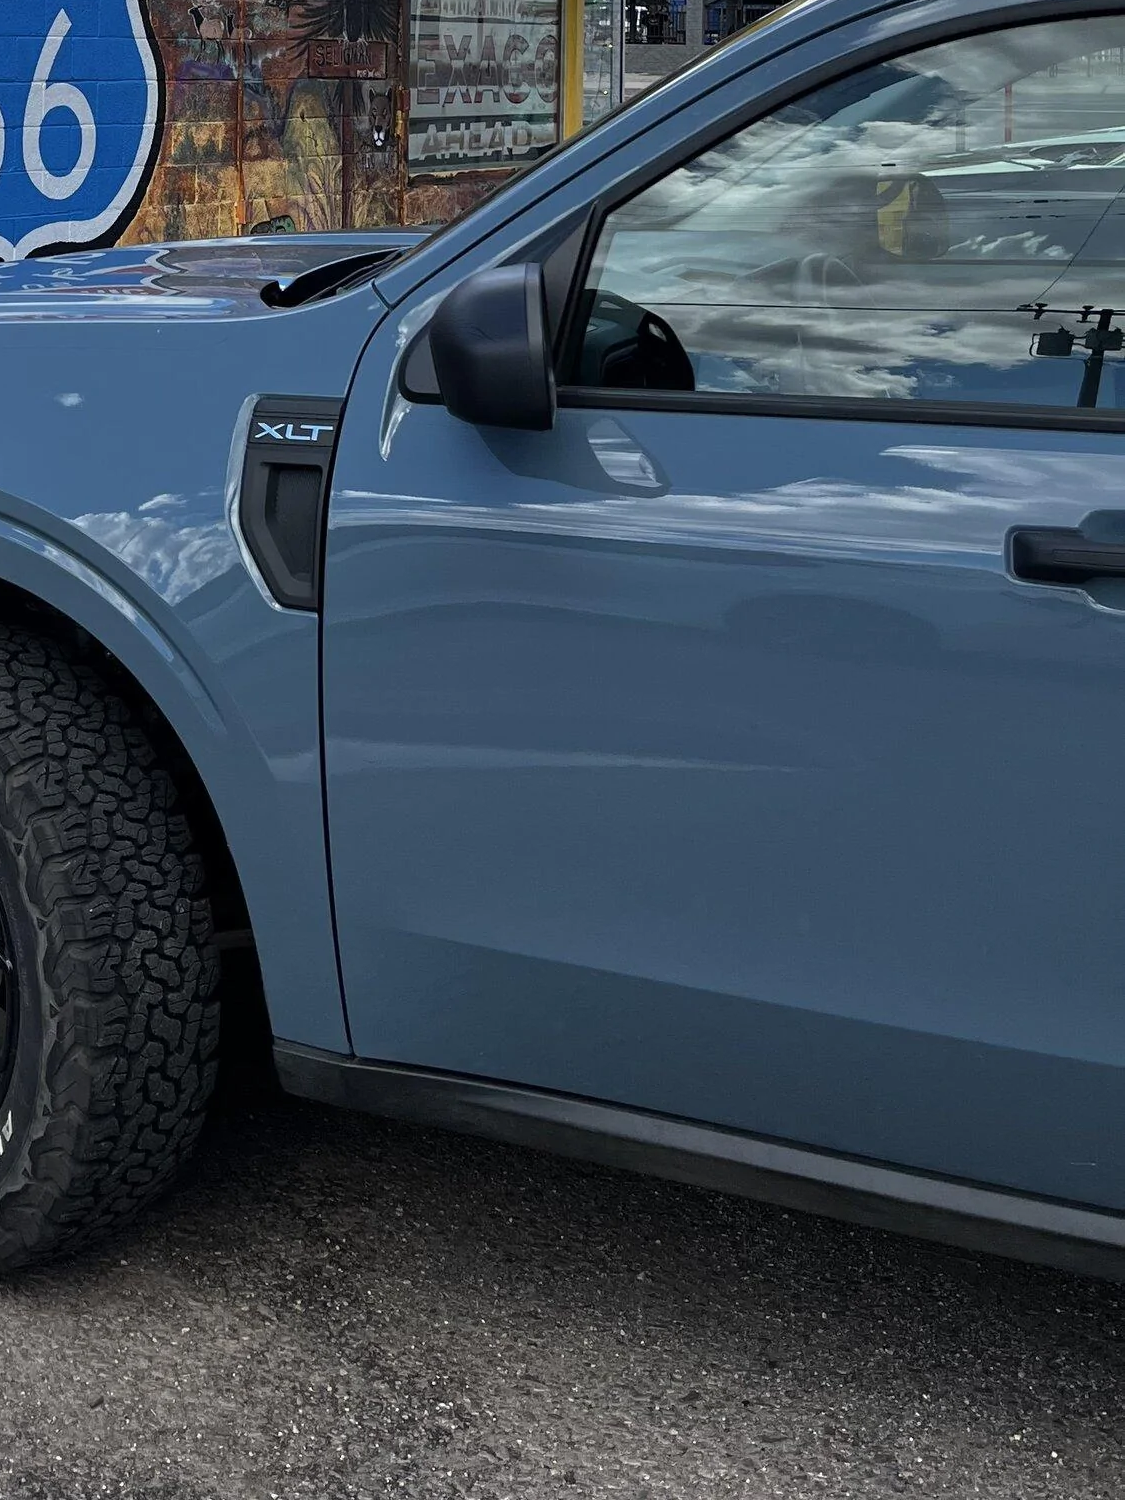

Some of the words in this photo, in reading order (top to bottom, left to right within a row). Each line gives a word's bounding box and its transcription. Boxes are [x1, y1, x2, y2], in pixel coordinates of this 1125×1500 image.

[411, 34, 559, 104] EXACO
[418, 120, 533, 161] AHEAD
[254, 421, 334, 442] XLT
